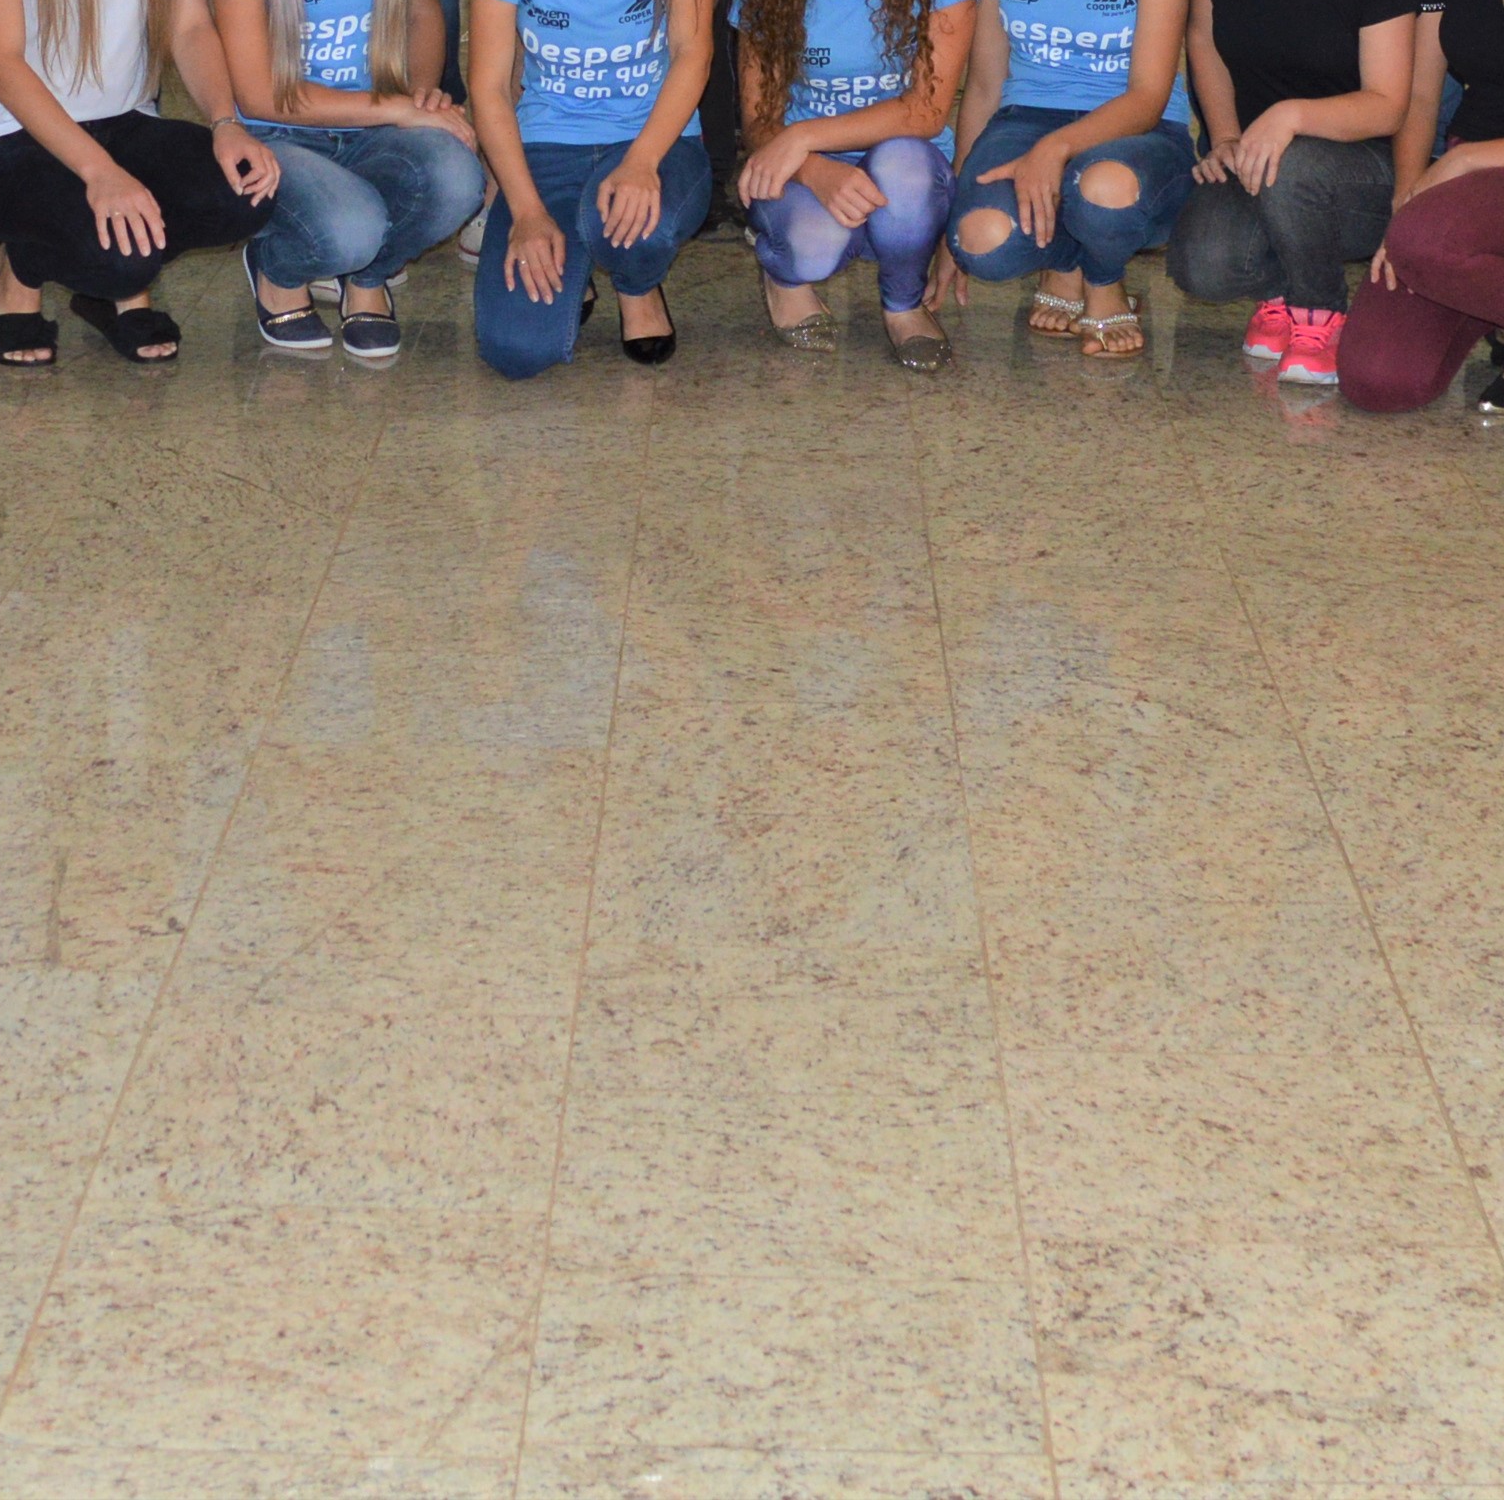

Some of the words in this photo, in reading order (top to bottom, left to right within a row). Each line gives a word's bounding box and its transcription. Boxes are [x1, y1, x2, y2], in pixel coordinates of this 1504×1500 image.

[619, 9, 652, 24] COOPER
[300, 12, 371, 44] espe
[999, 7, 1132, 49] espert
[300, 43, 356, 60] líder
[523, 28, 668, 68] Despert
[551, 65, 607, 81] líder
[616, 60, 659, 83] que
[802, 56, 830, 68] oop
[321, 67, 357, 82] em
[804, 70, 912, 95] esper
[574, 87, 611, 98] em
